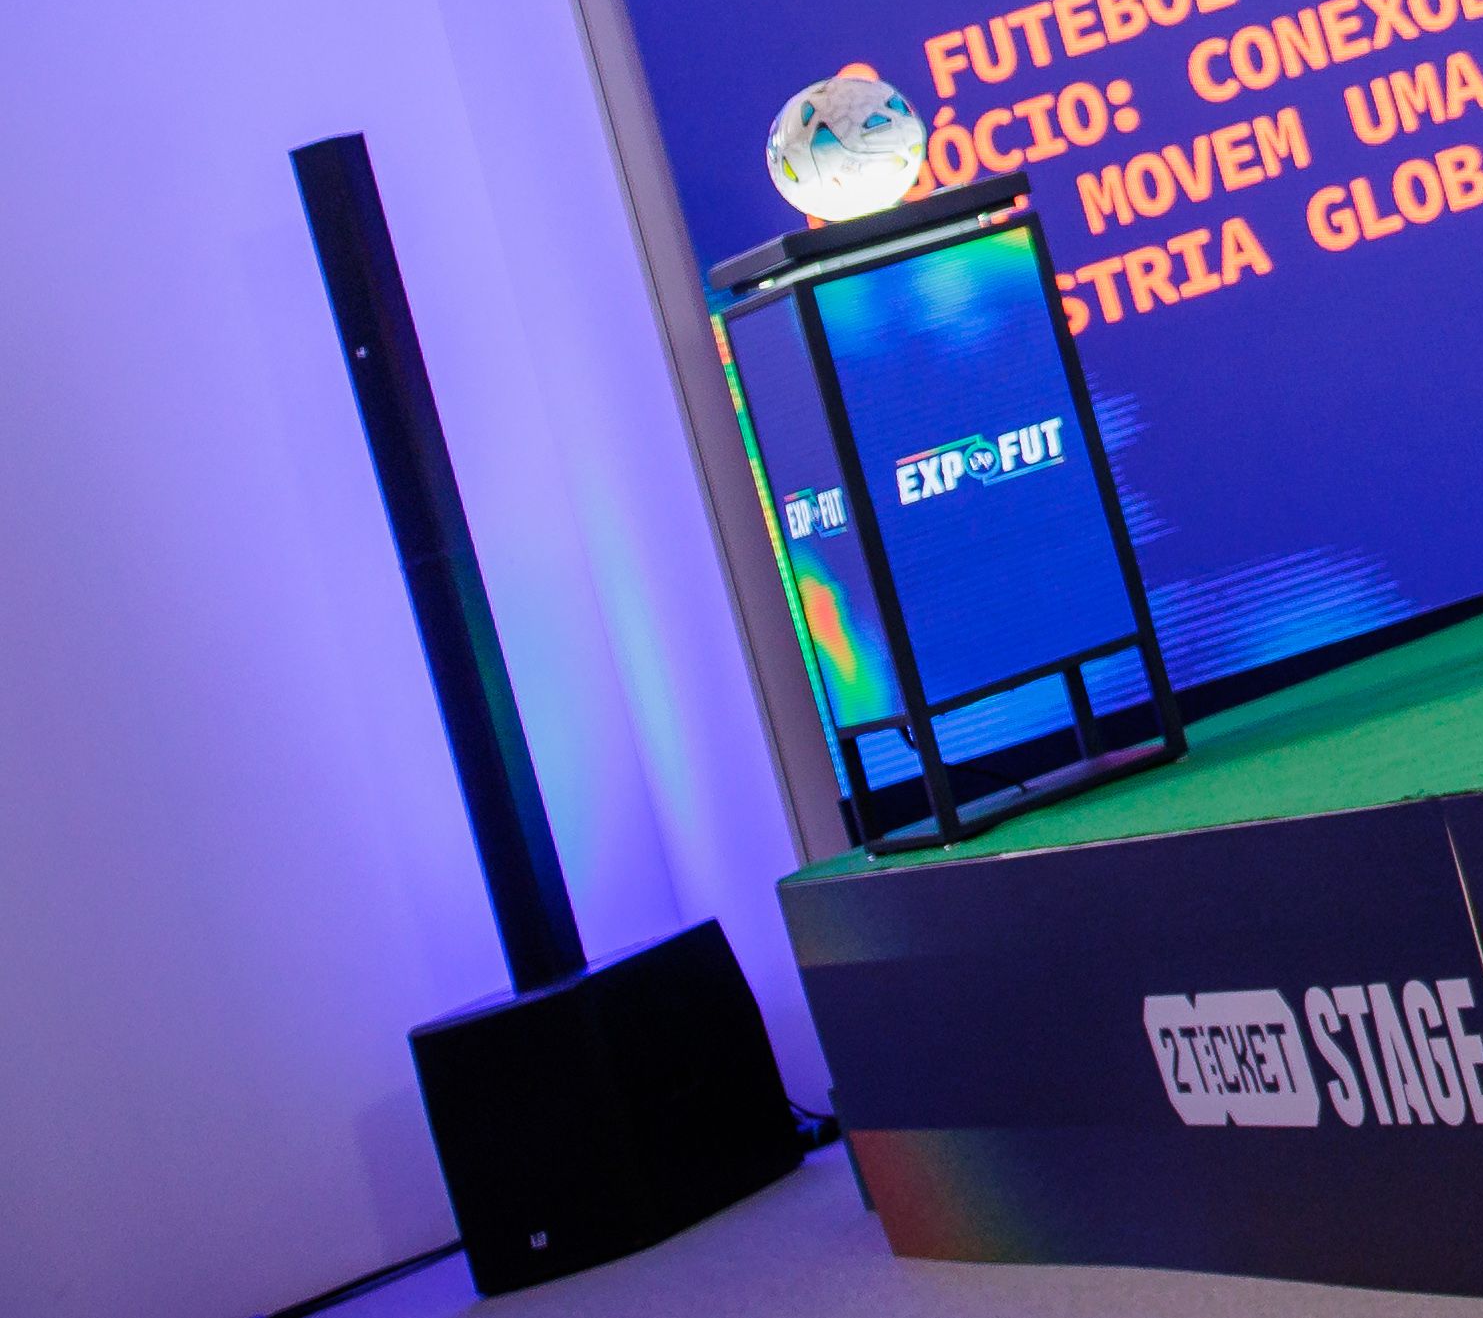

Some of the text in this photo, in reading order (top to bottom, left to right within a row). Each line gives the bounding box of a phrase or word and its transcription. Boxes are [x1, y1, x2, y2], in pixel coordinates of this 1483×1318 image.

[904, 77, 1141, 203] ÓCIO:
[1076, 115, 1310, 235] MOVEM
[1055, 218, 1274, 337] STRIA
